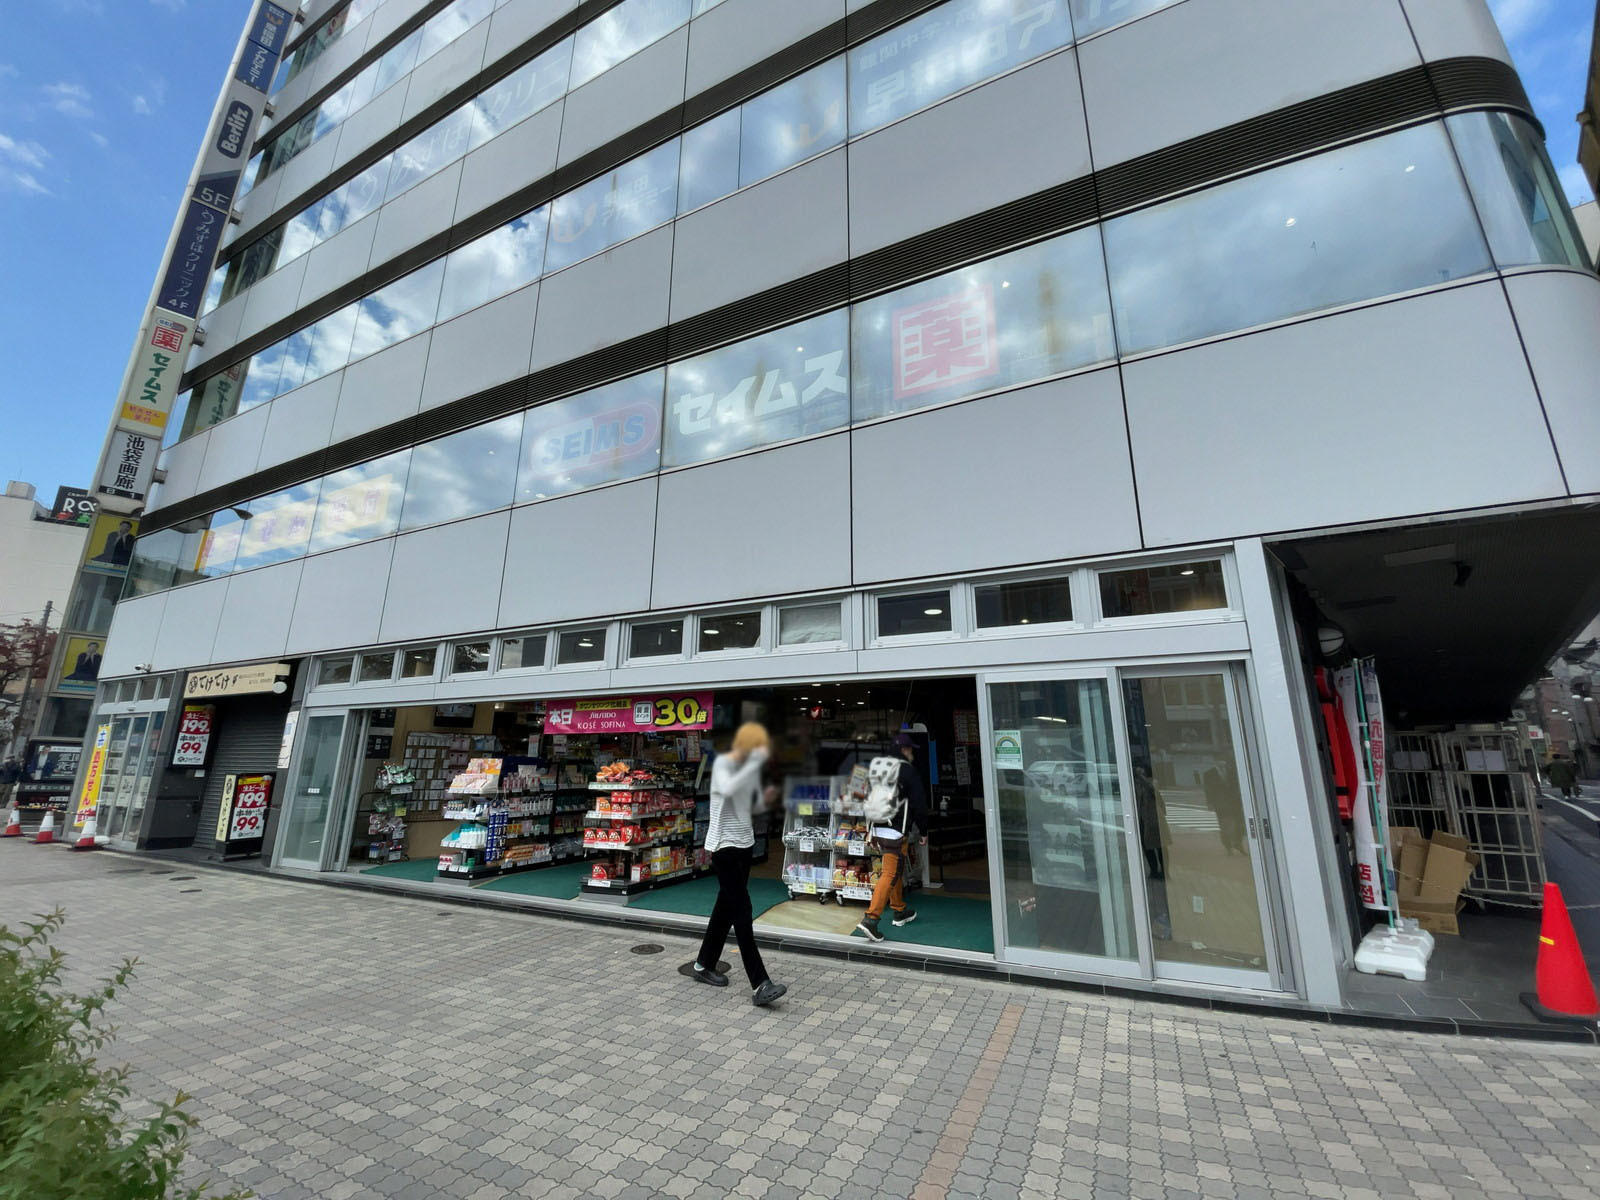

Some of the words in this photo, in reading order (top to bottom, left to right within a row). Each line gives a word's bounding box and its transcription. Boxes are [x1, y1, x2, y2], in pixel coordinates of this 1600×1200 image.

[221, 106, 249, 153] Berlitz
[200, 187, 230, 206] 5F
[152, 327, 183, 352] 薬
[900, 296, 990, 392] 薬
[140, 352, 171, 404] セイムス
[672, 350, 848, 437] セイムス
[113, 435, 145, 489] 池袋画廊
[541, 415, 646, 466] SEIMS
[199, 672, 230, 693] てけてけ
[549, 708, 573, 725] 本日
